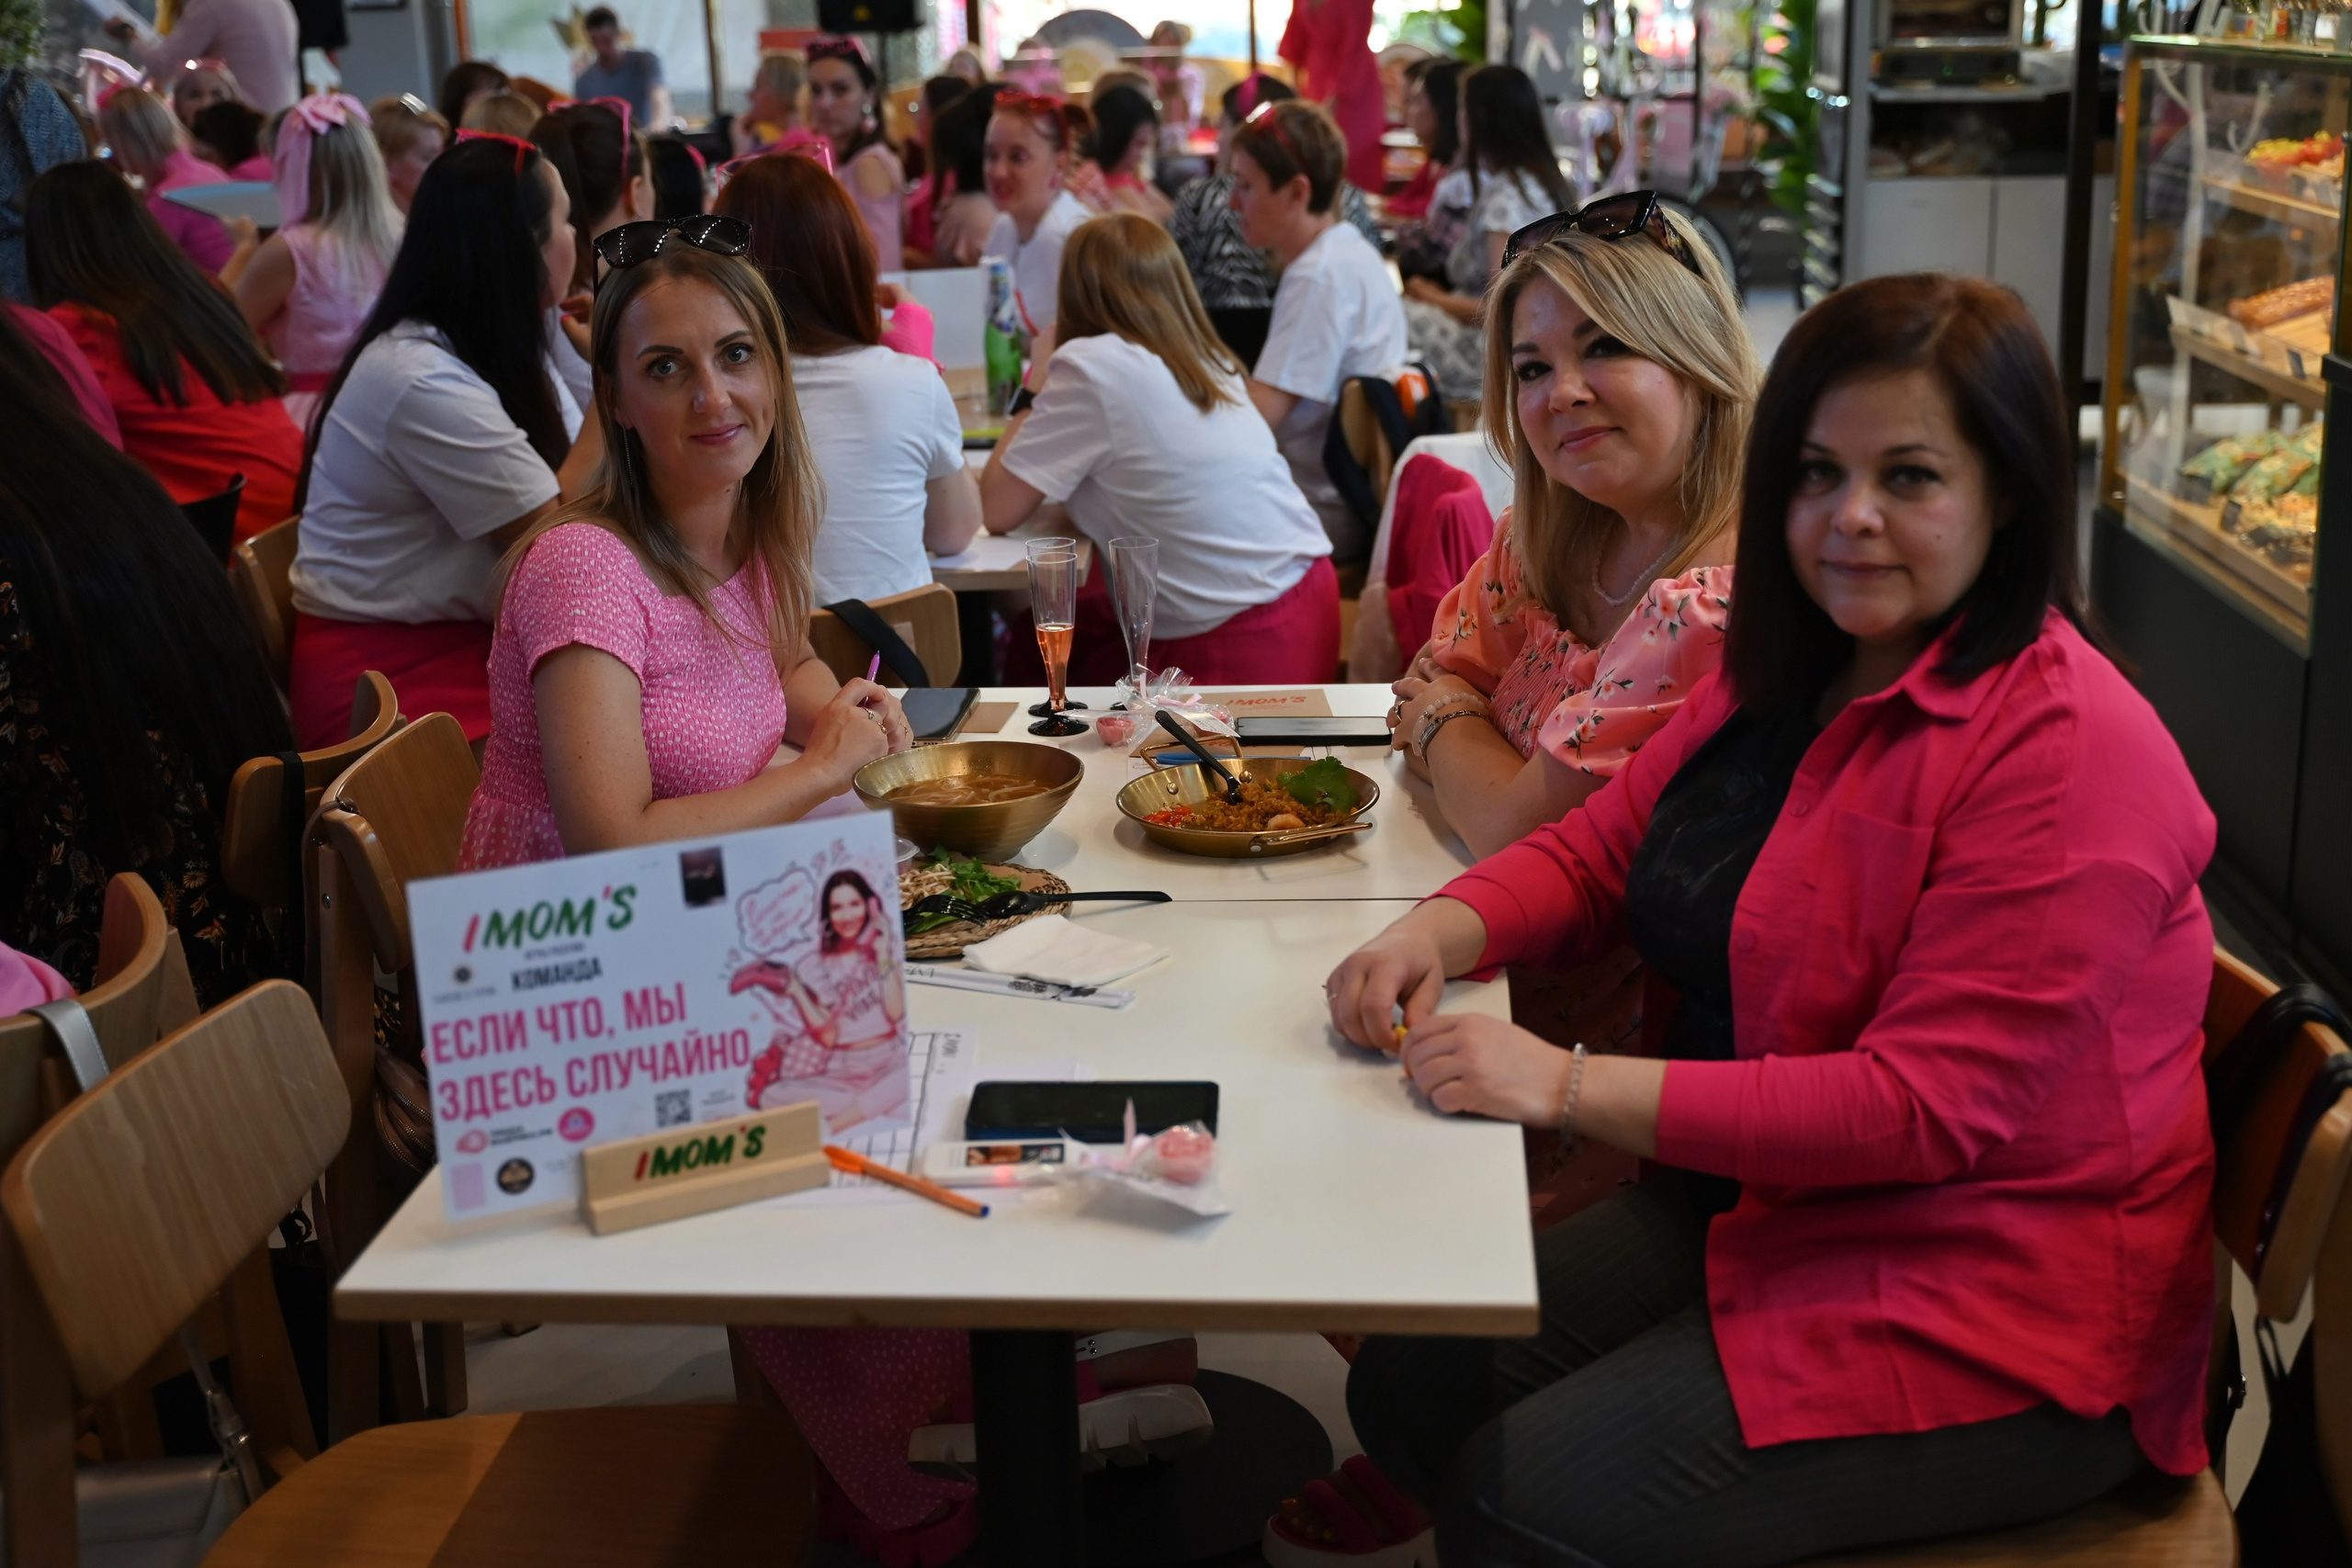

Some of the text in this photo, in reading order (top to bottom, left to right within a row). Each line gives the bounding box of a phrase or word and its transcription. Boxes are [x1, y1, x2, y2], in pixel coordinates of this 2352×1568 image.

[431, 982, 686, 1065] ЕСЛИ ЧТО, МЫ
[437, 1028, 752, 1122] ЗДЕСЬ СЛУЧАЙНО
